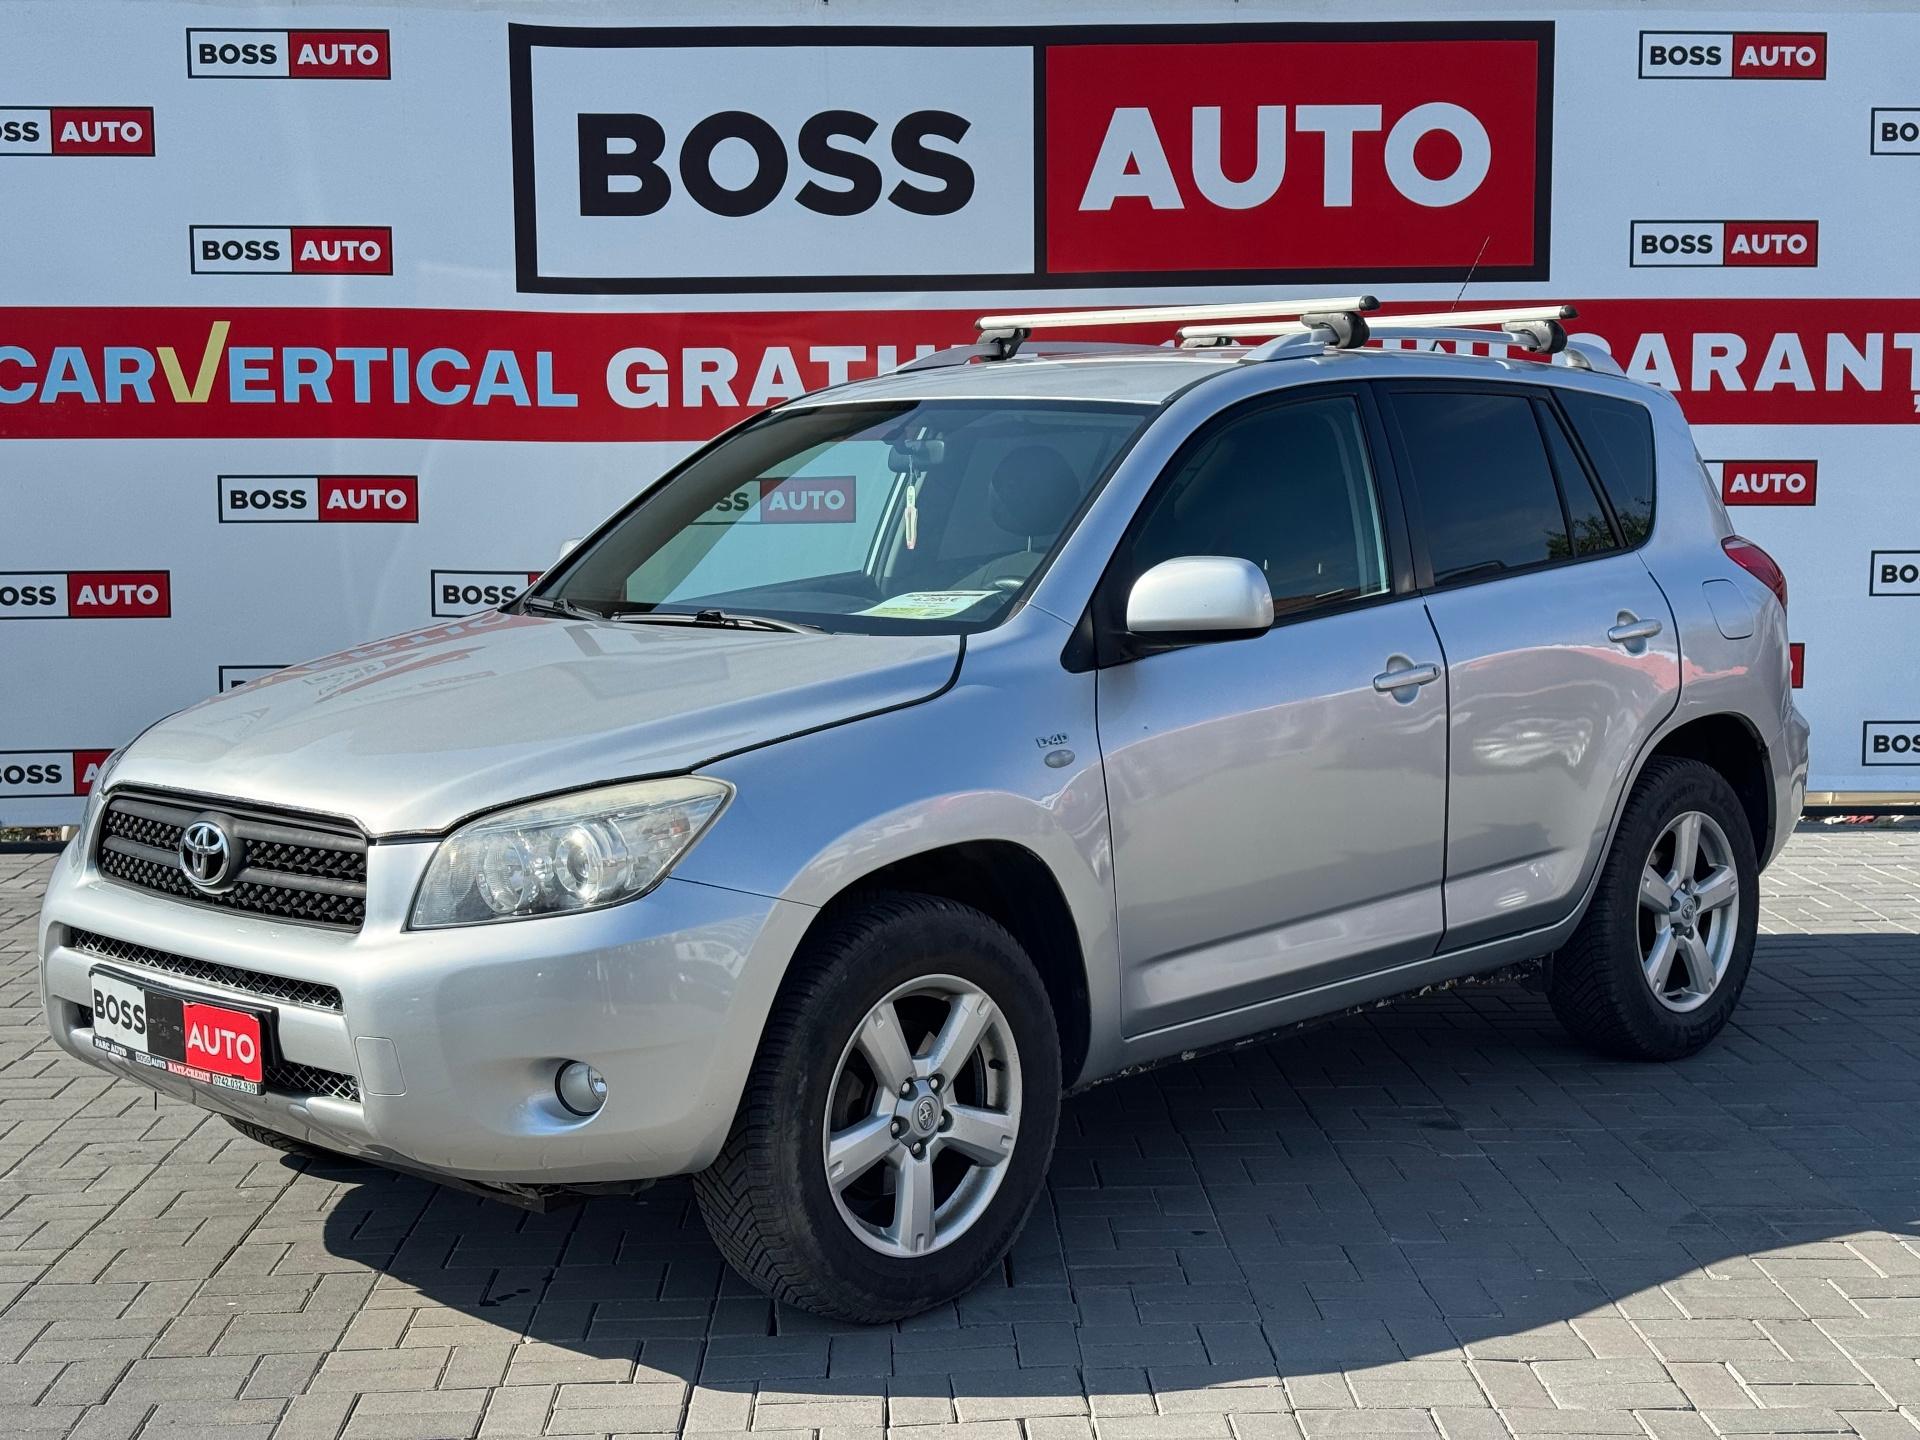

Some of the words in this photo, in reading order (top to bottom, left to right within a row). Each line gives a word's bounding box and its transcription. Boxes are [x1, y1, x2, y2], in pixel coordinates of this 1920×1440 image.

[199, 44, 277, 65] BOSS
[297, 44, 379, 66] AUTO
[1649, 46, 1722, 66] BOSS
[1739, 46, 1817, 67] AUTO
[0, 121, 40, 143] SS
[60, 121, 143, 143] AUTO
[577, 109, 976, 218] BOSS
[1078, 101, 1492, 212] AUTO
[202, 240, 281, 261] BOSS
[299, 241, 381, 262] AUTO
[1641, 234, 1713, 255] BOSS
[1731, 234, 1808, 255] AUTO
[0, 320, 579, 408] CARVERTICAL
[1730, 473, 1807, 494] AUTO
[230, 489, 307, 510] BOSS
[326, 489, 407, 510] AUTO
[768, 490, 846, 511] AUTO
[1881, 564, 1920, 584] BO
[76, 585, 159, 606] AUTO
[443, 585, 517, 605] BOSS
[0, 764, 63, 785] OSS
[93, 988, 146, 1034] BOSS
[187, 1022, 256, 1064] AUTO
[110, 1043, 128, 1057] AUTO
[136, 1053, 151, 1065] BOSS
[151, 1058, 167, 1070] AUTO
